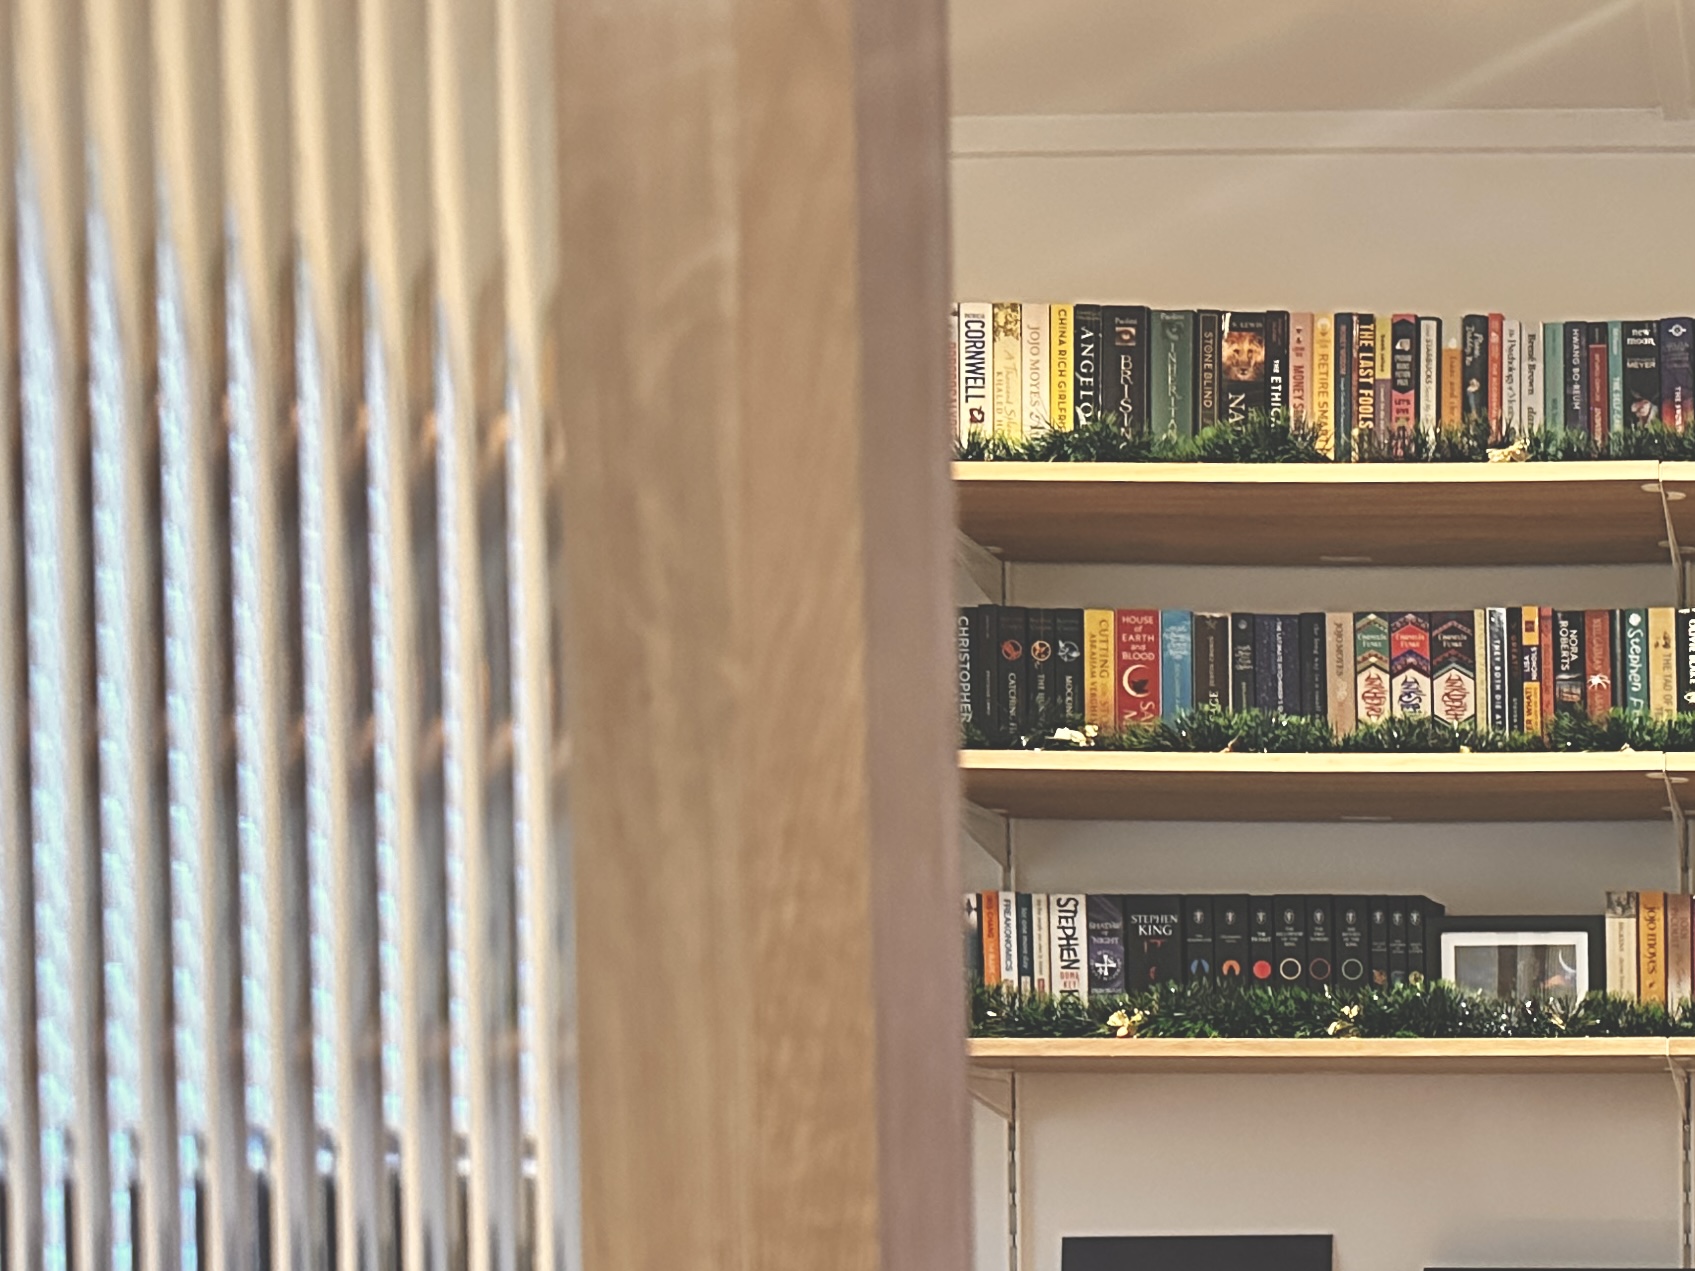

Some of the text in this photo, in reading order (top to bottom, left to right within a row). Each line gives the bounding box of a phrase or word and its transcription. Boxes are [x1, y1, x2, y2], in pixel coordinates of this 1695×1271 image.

[964, 320, 986, 404] CORNWELL
[1027, 325, 1041, 407] JOJO MOYES
[1057, 309, 1068, 378] CHINA RICH
[1203, 331, 1214, 409] STONE BLIND
[1572, 329, 1581, 365] HWANG
[1627, 361, 1656, 369] MEYER
[1293, 365, 1305, 401] MONEY
[1317, 353, 1330, 399] RETIRE
[1359, 324, 1374, 429] THE LAST FOOLS
[1527, 364, 1538, 396] Brown
[1122, 616, 1154, 625] HOUSE
[1122, 633, 1155, 643] EARTH
[1559, 620, 1570, 671] ROBERTS
[1569, 629, 1578, 661] NORA
[958, 616, 972, 723] CHRISTOPHER
[1099, 619, 1110, 679] CUTTING
[1122, 651, 1156, 661] BLOOD
[1334, 622, 1344, 677] JOJO MOYES
[1627, 628, 1644, 692] Stephen
[1662, 653, 1672, 671] THE
[1494, 639, 1502, 726] THEY BOTH DIE AT
[1003, 898, 1013, 972] FREAKONOMICS
[1056, 897, 1081, 970] STEPHEN
[1131, 914, 1179, 925] STEPHEN
[1138, 924, 1173, 937] KING
[1644, 906, 1661, 975] jojo moyes
